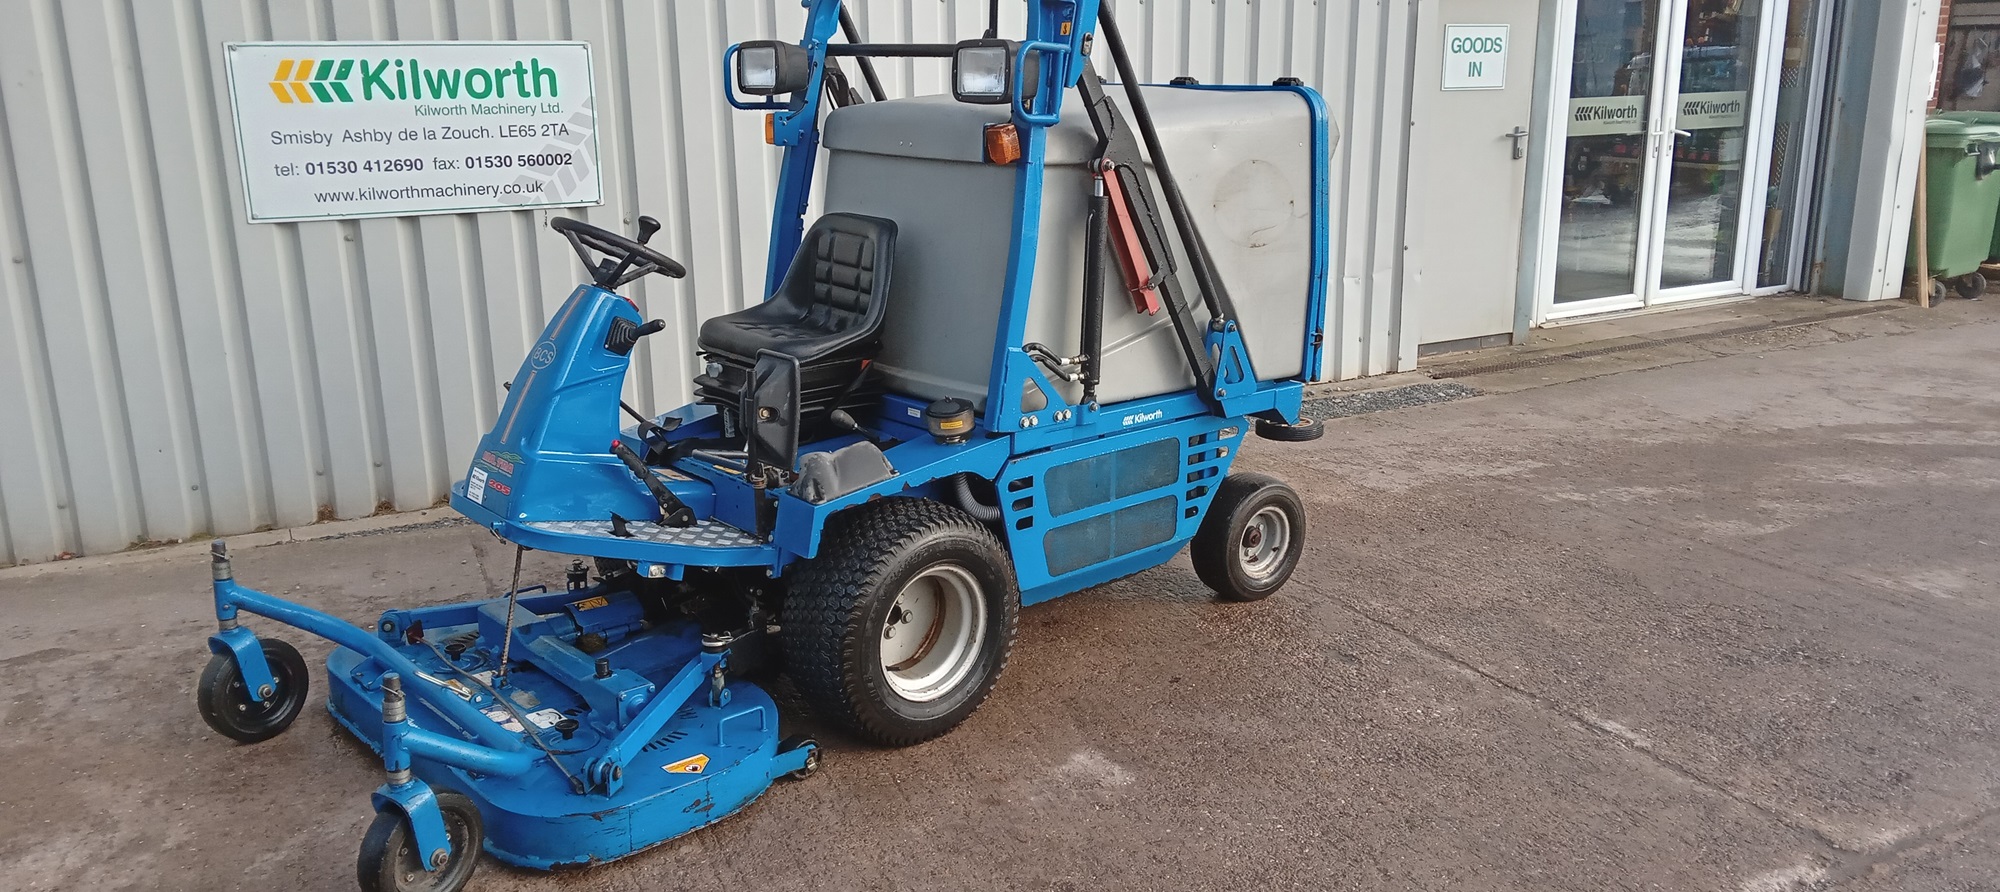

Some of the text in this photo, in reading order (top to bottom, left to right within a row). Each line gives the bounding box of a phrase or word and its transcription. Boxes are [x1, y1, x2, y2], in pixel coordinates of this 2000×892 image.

[1451, 37, 1502, 53] GOODS
[1468, 61, 1482, 77] IN
[360, 57, 558, 100] Kilworth
[414, 102, 564, 117] Kilworth Machinery Ltd.
[1593, 105, 1637, 119] Kilworth
[1700, 100, 1740, 114] Kilworth
[270, 123, 570, 147] Smisby Ashby de la Zouch. LE65 2TA
[274, 152, 573, 177] tel: 01530 412690 fax: 01530 560002
[314, 181, 543, 202] www.kilworthmachinery.co.uk
[534, 347, 554, 364] BCS
[1134, 409, 1162, 423] Kilworth
[489, 479, 511, 495] 205
